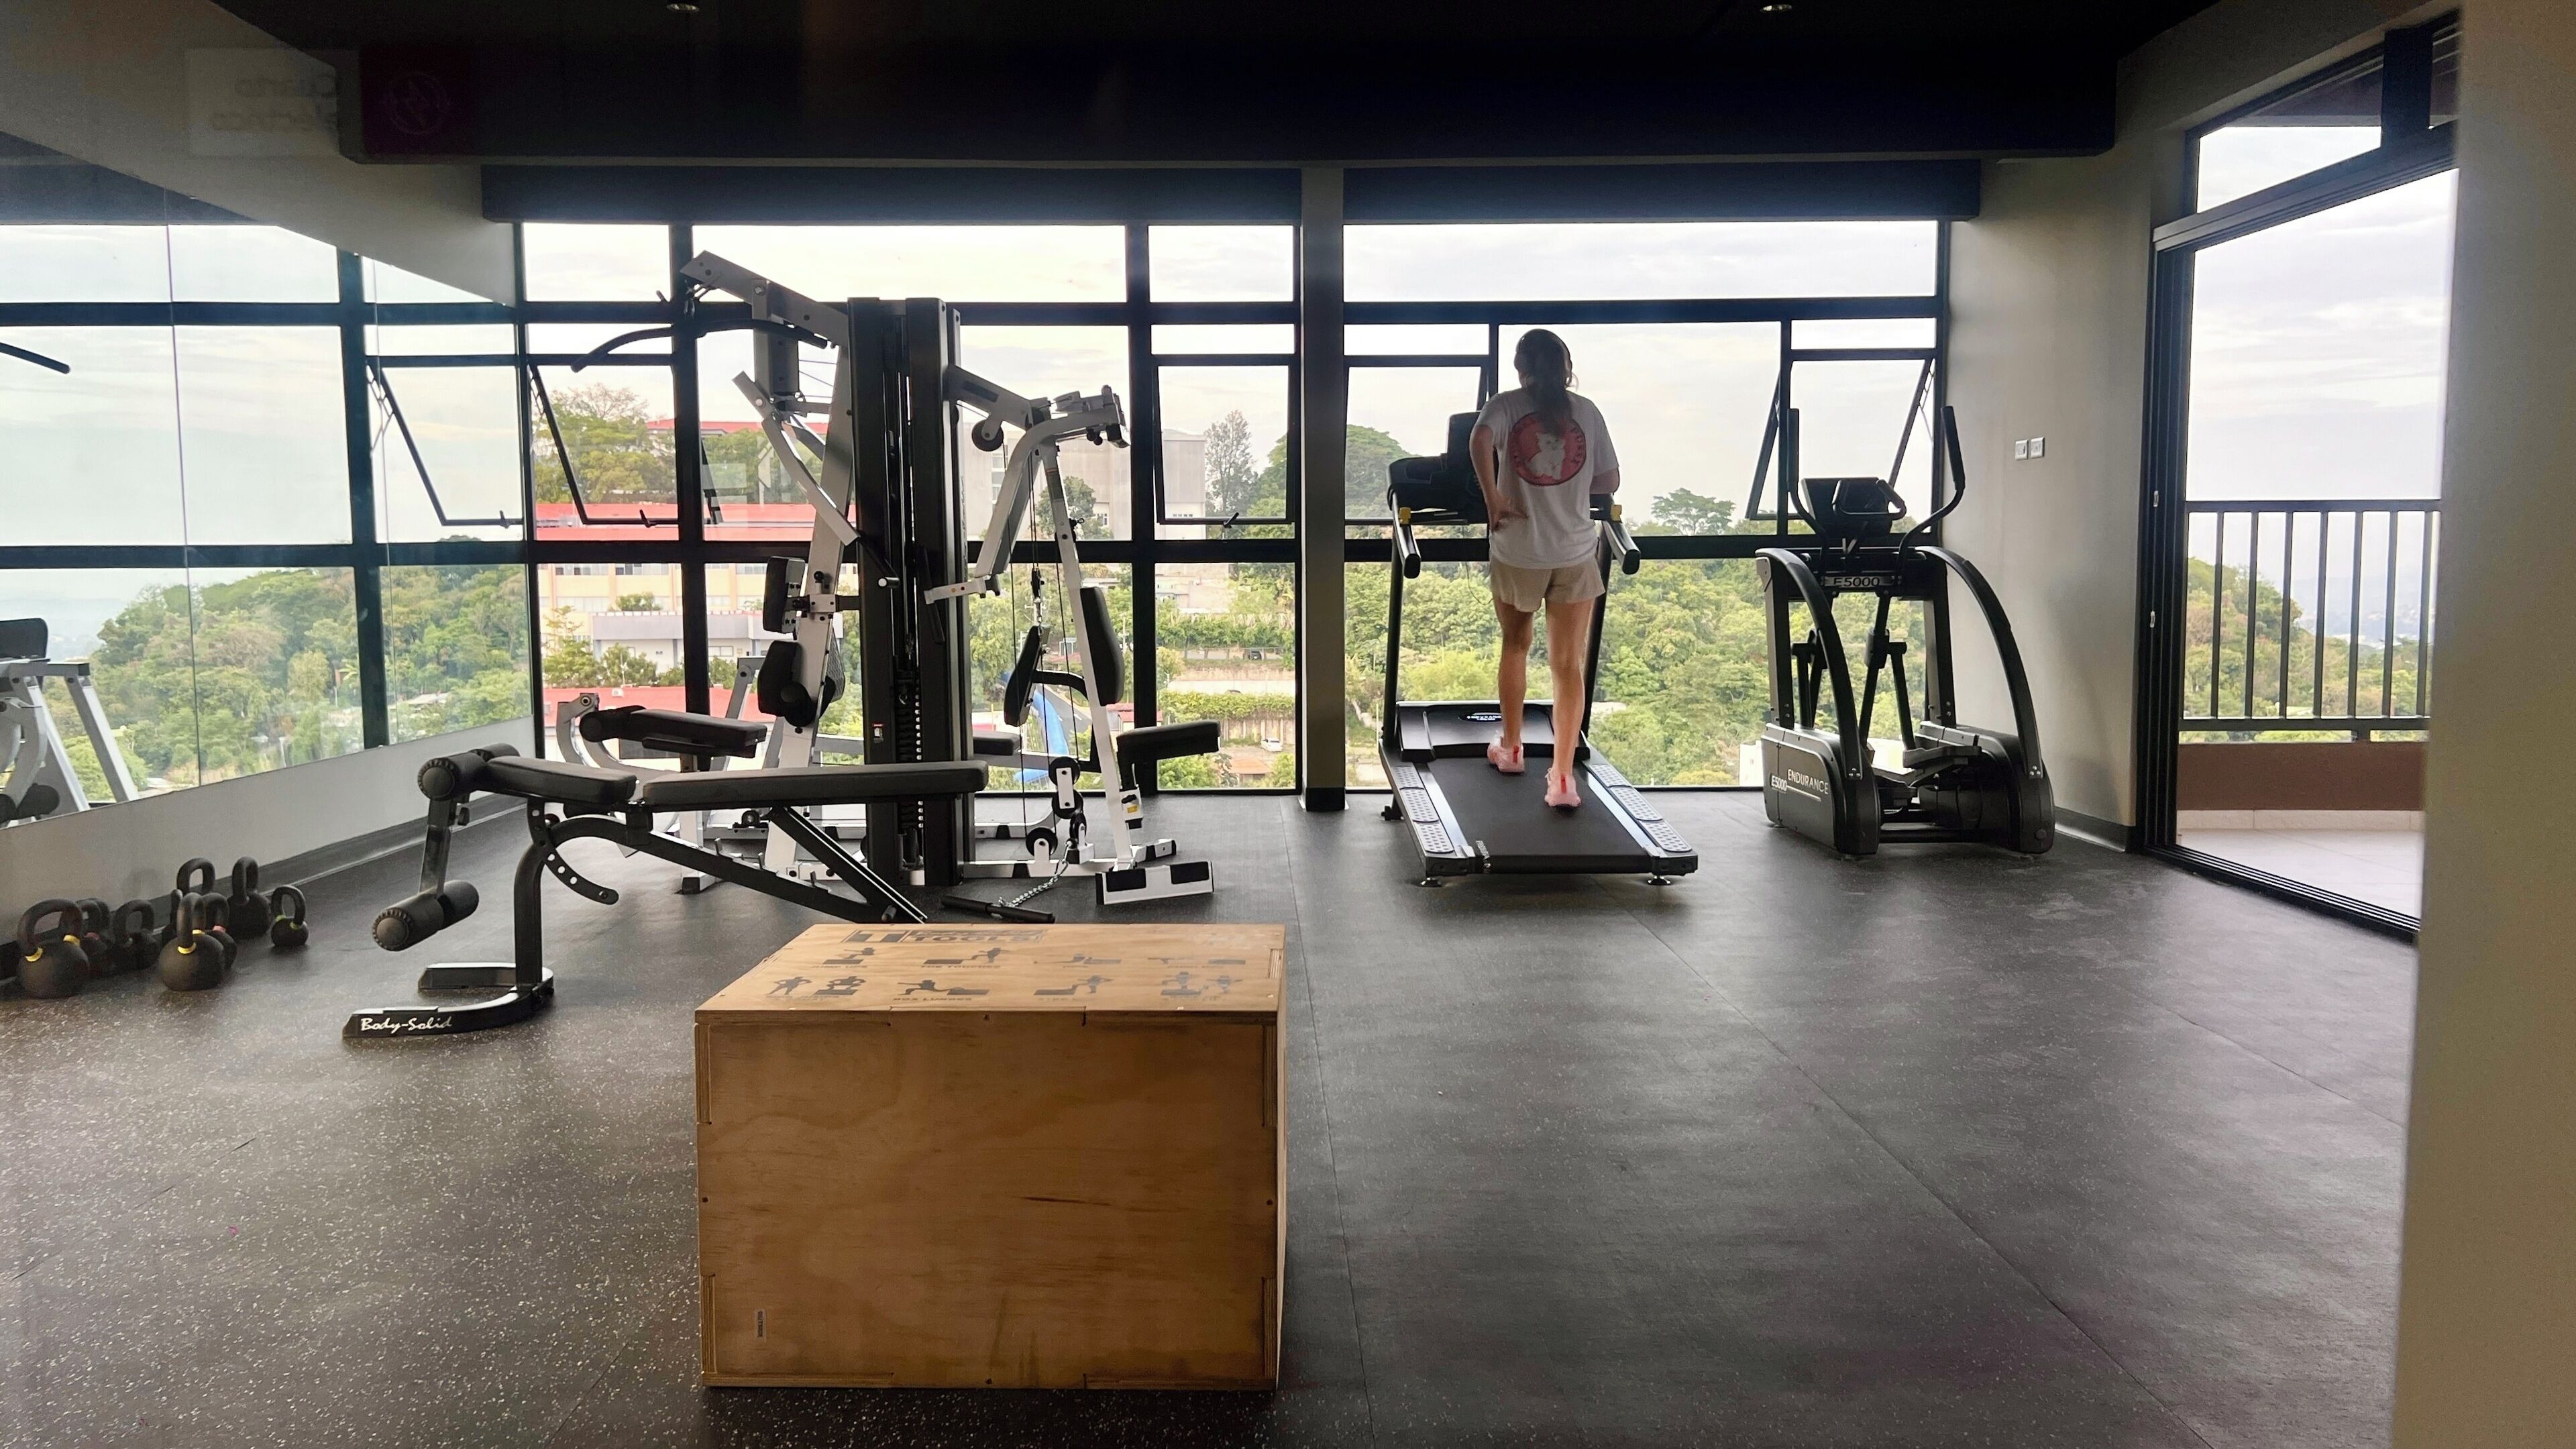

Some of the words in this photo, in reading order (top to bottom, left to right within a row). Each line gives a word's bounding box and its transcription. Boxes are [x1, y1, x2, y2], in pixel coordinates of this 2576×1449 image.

[1771, 775, 1788, 792] E5000
[1788, 769, 1829, 795] ENDURANCE
[361, 1016, 452, 1034] Body-Solid
